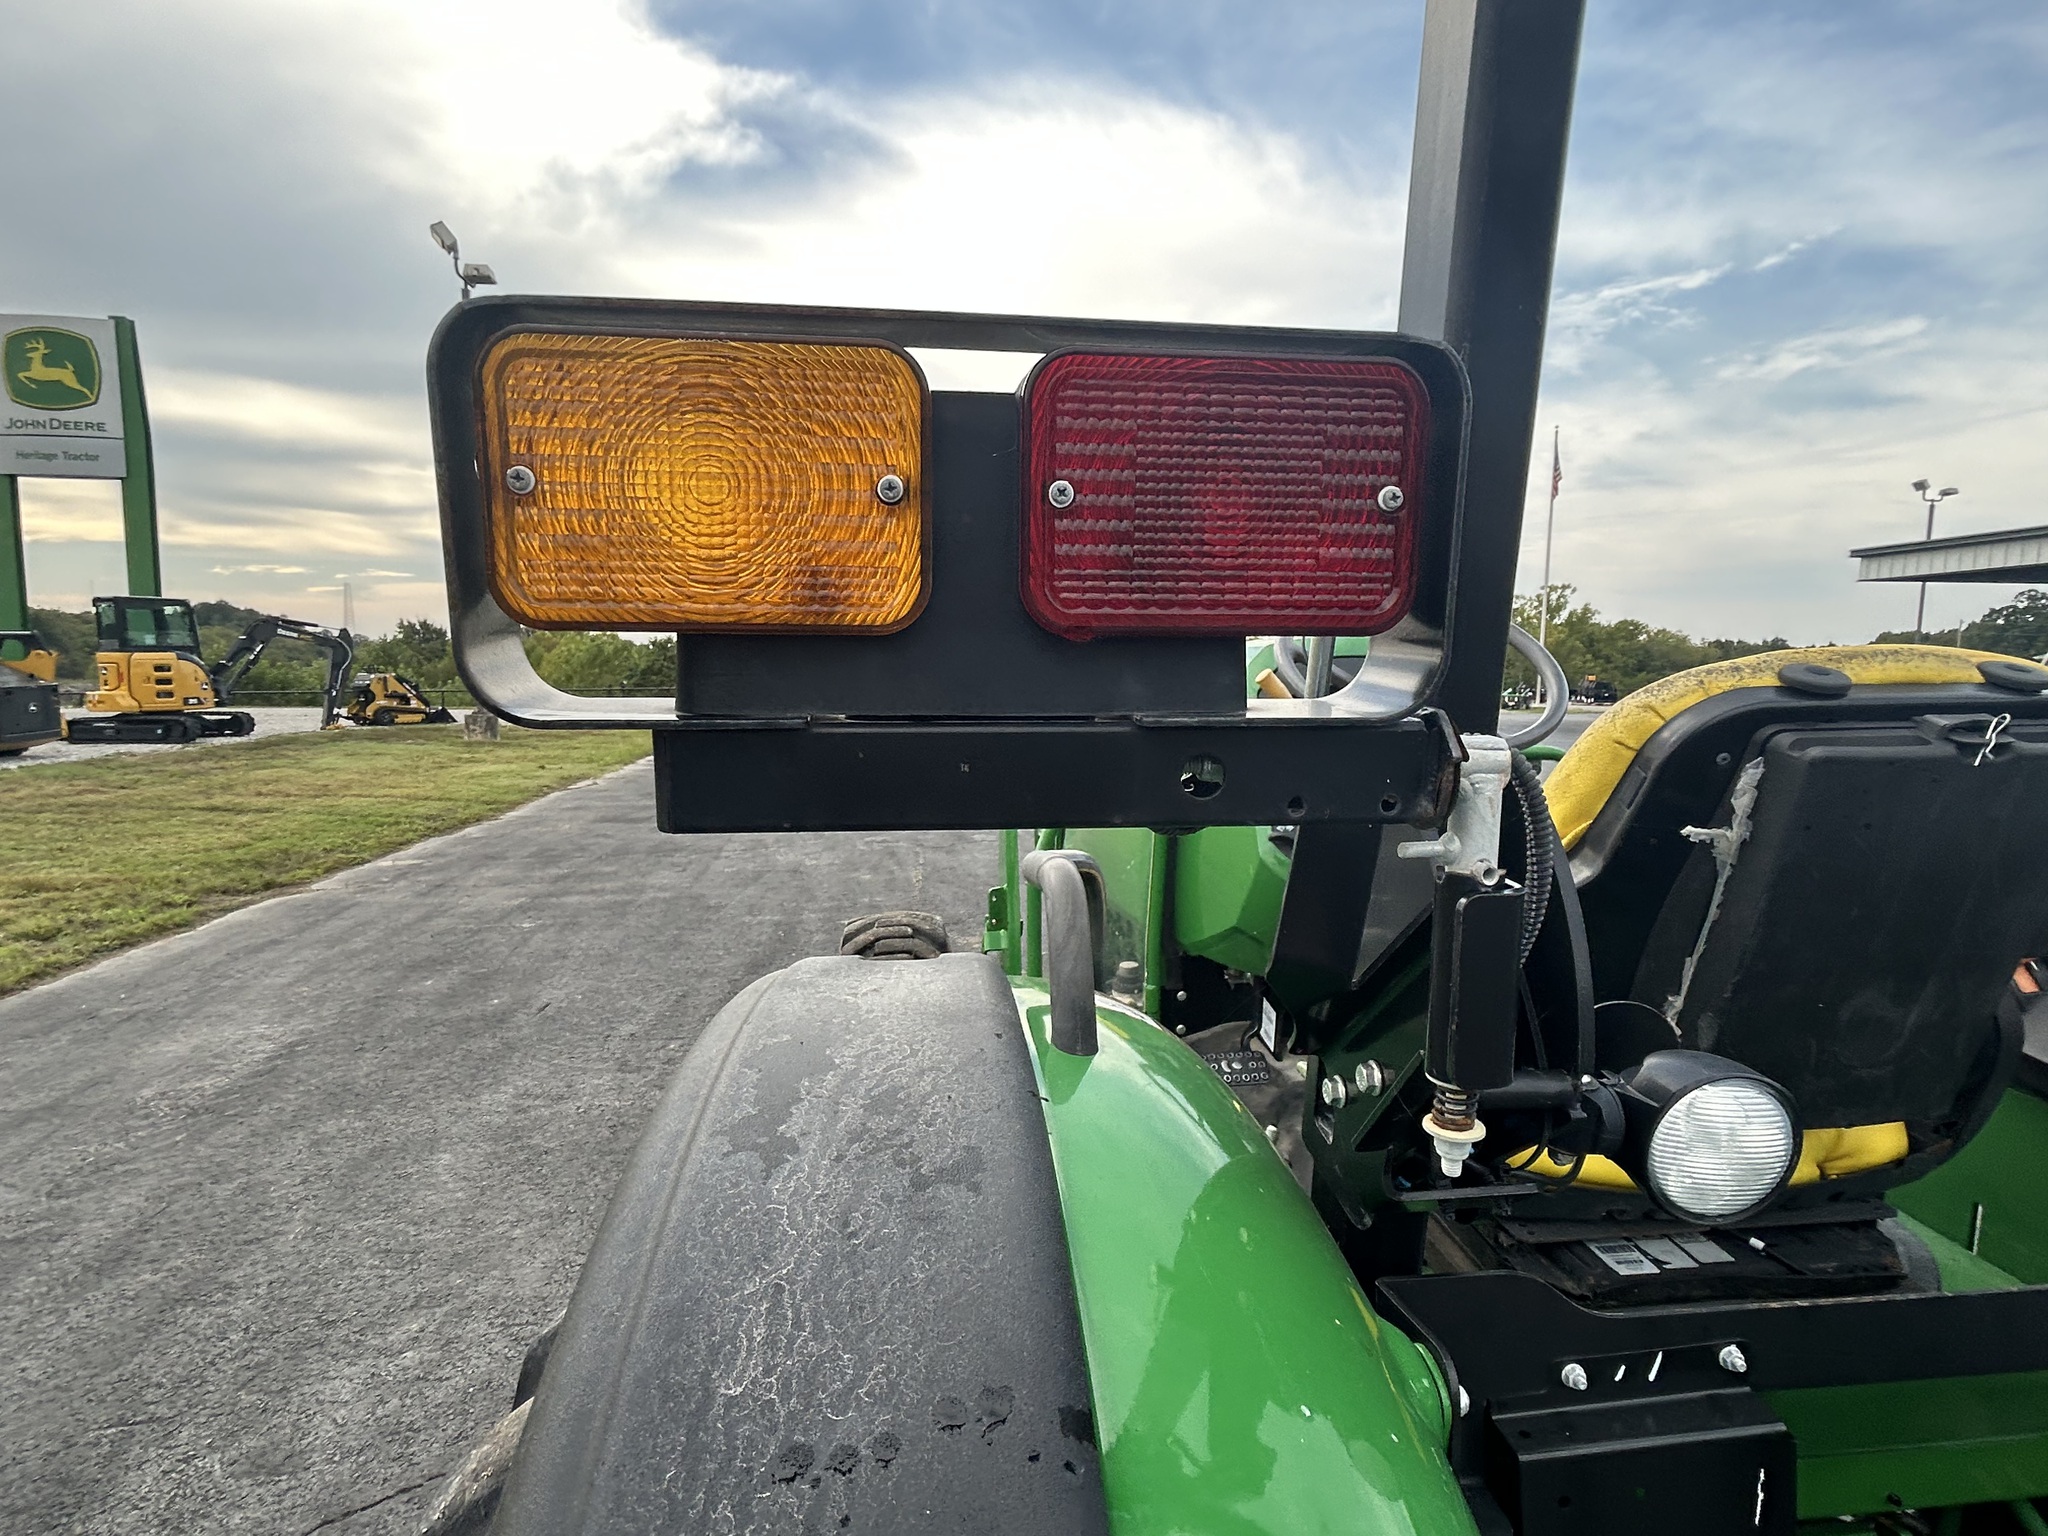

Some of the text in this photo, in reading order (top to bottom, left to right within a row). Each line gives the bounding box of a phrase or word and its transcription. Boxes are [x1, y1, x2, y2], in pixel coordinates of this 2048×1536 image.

[5, 418, 107, 432] JOHN DEERE
[16, 450, 100, 462] Heritage Tractor
